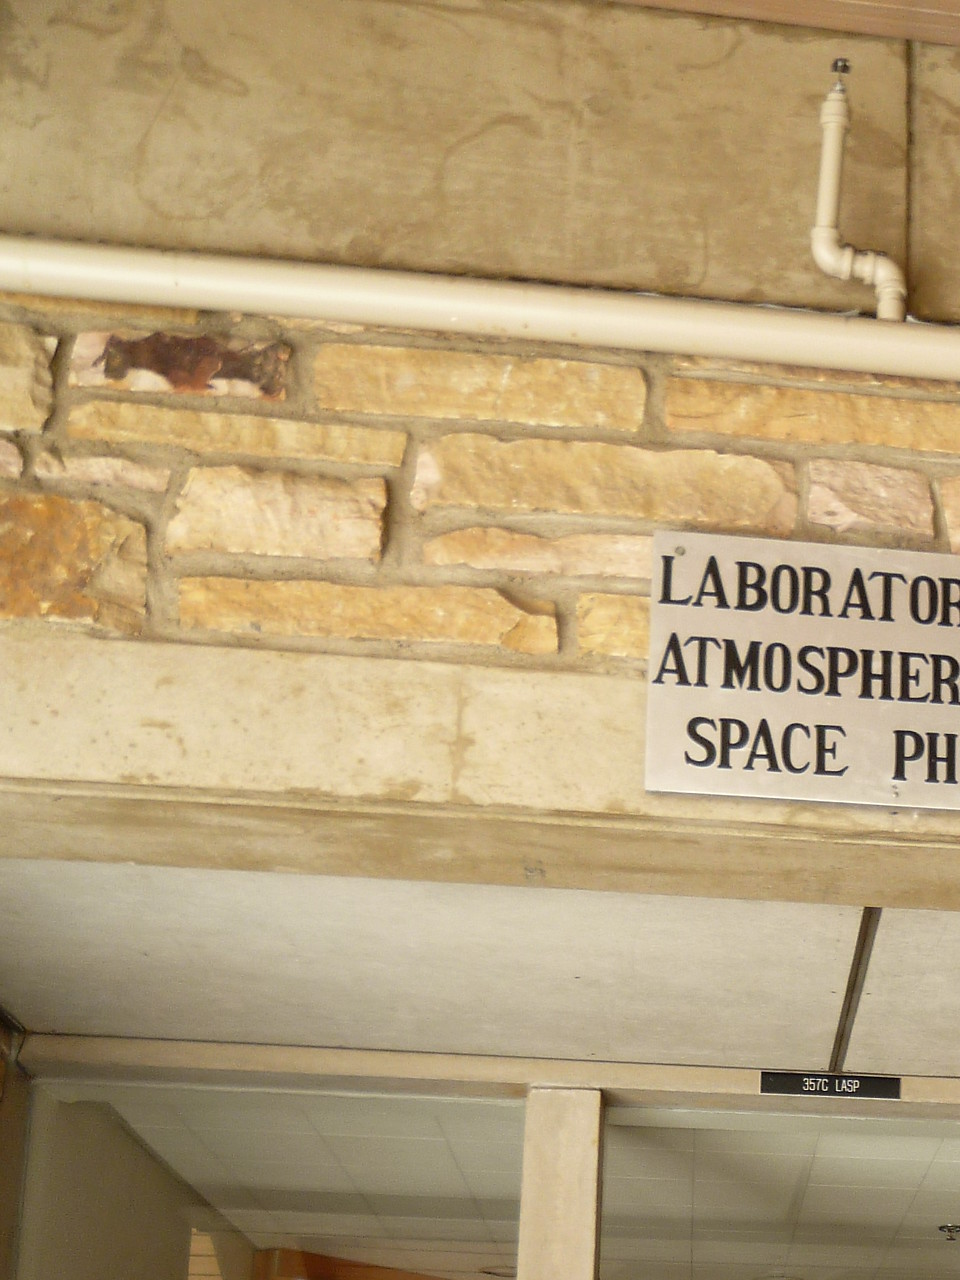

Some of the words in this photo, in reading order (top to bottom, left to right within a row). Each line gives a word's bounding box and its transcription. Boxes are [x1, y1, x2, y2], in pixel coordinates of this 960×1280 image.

[684, 716, 850, 777] SPACE
[802, 1077, 829, 1092] 357C
[835, 1079, 860, 1093] LASP
